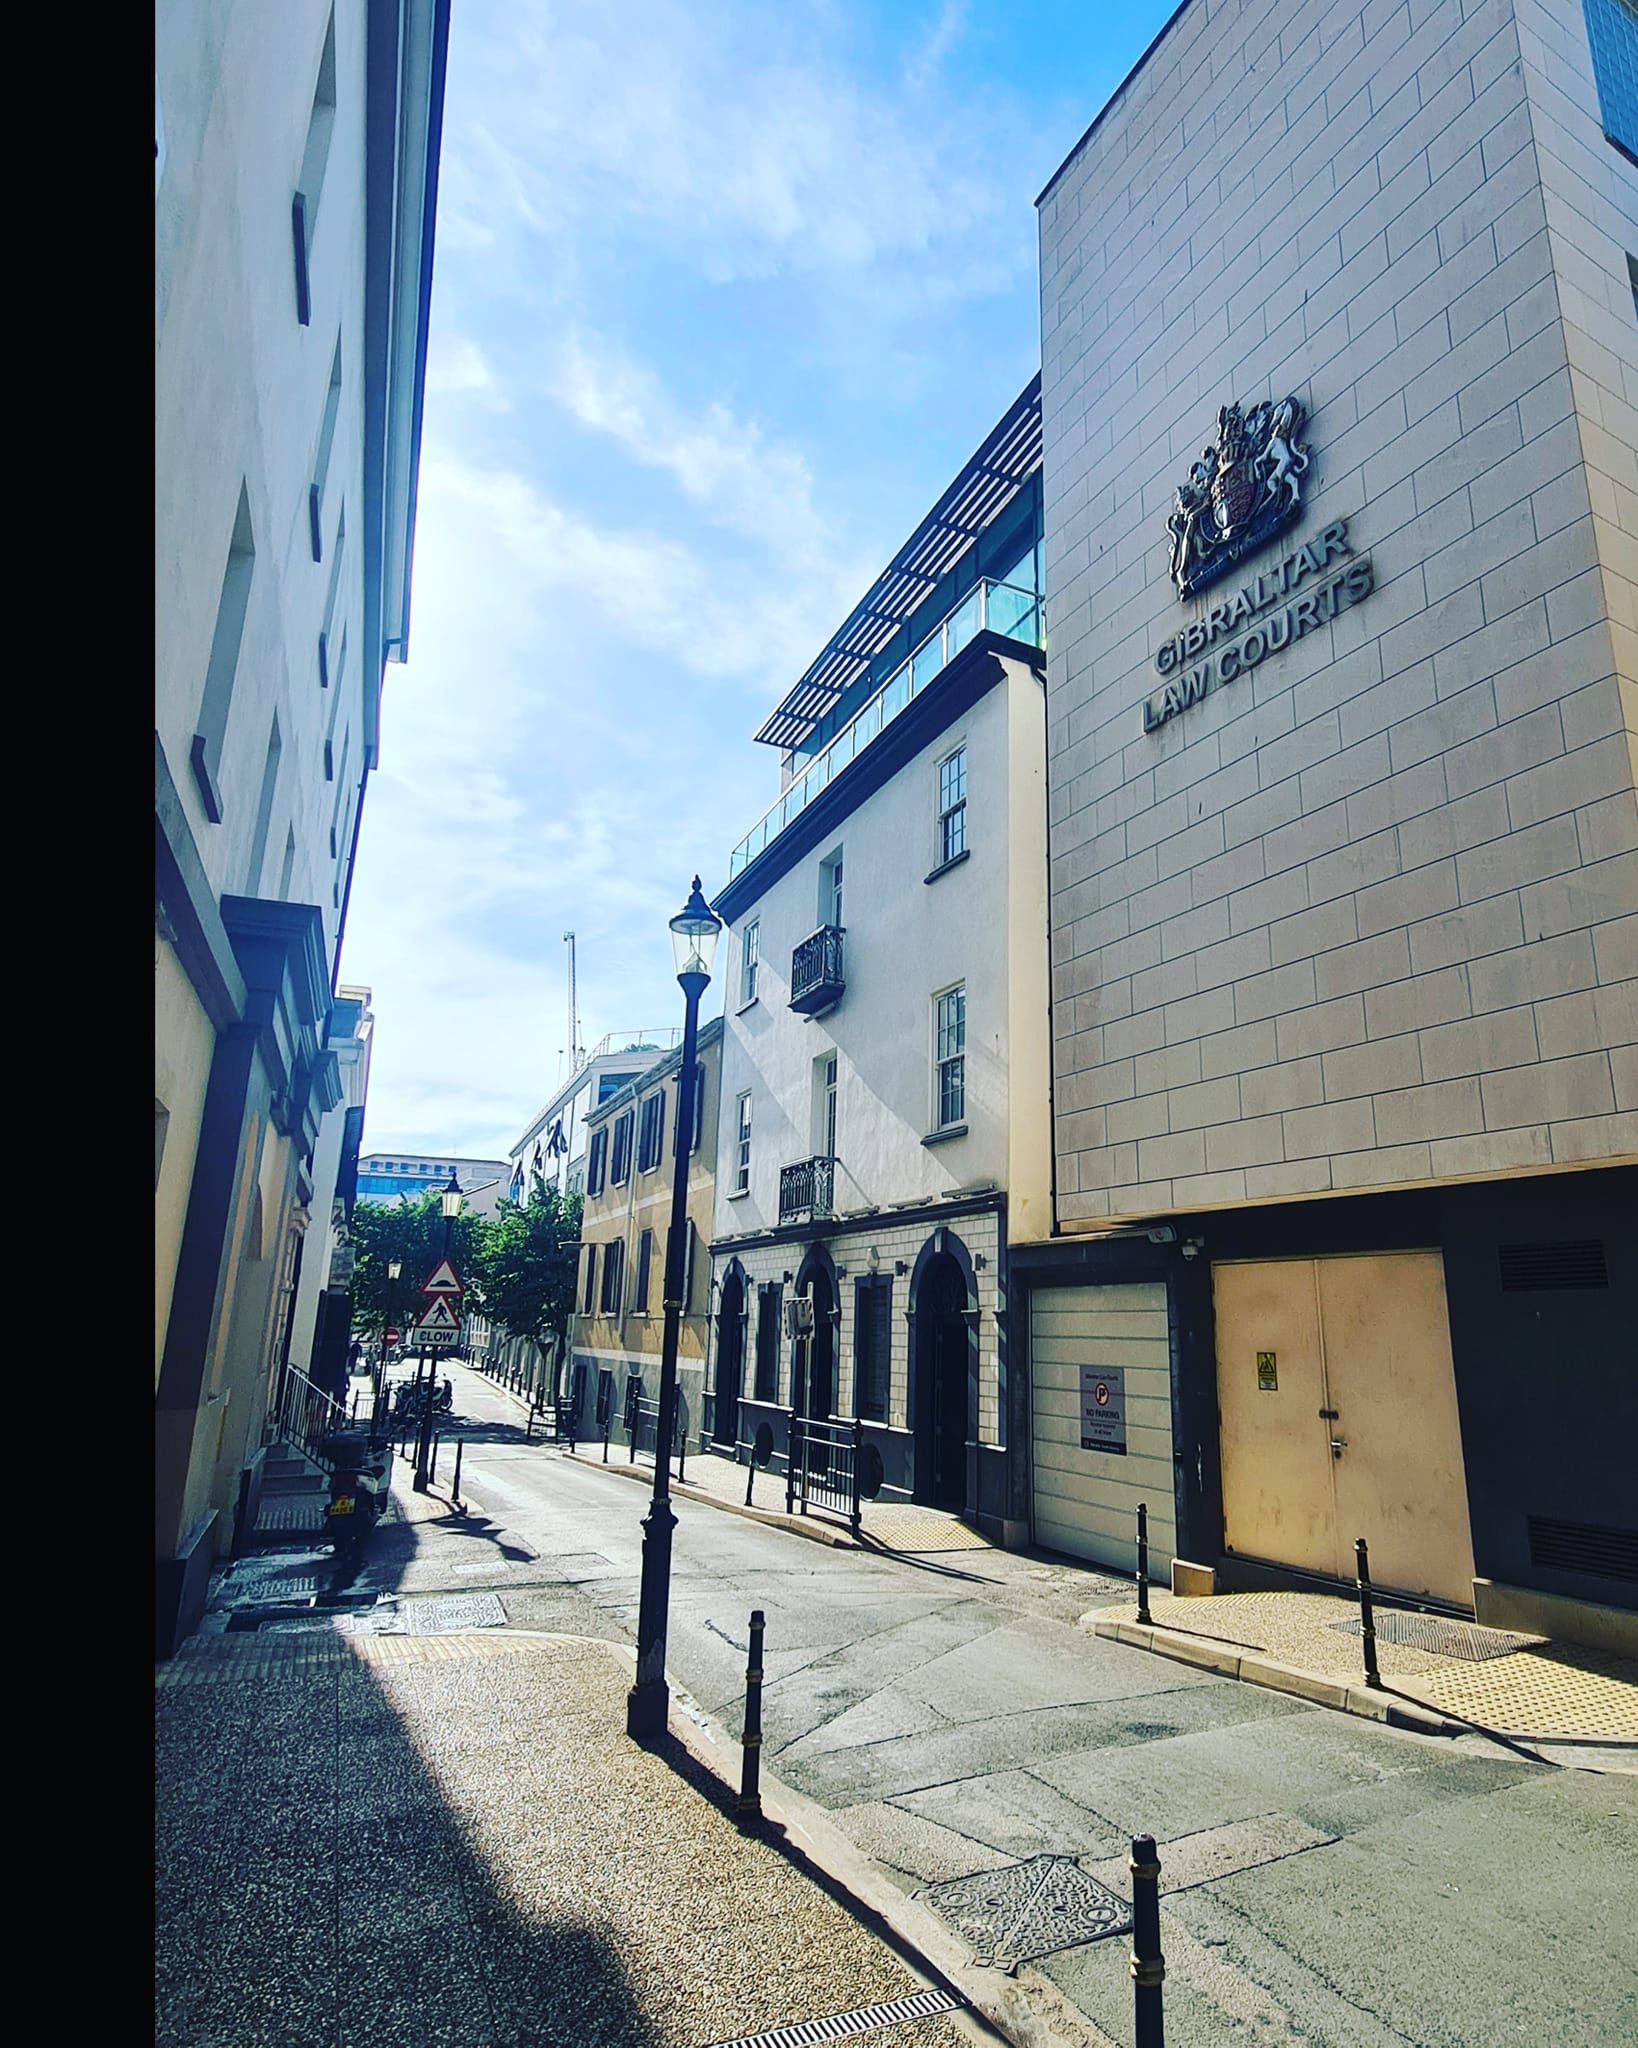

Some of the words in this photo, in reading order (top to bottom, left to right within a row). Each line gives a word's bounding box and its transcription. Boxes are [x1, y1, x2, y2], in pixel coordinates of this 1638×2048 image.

[1141, 661, 1208, 735] LAW
[1217, 560, 1375, 683] COURTS
[1153, 519, 1351, 676] GIBRALTAR
